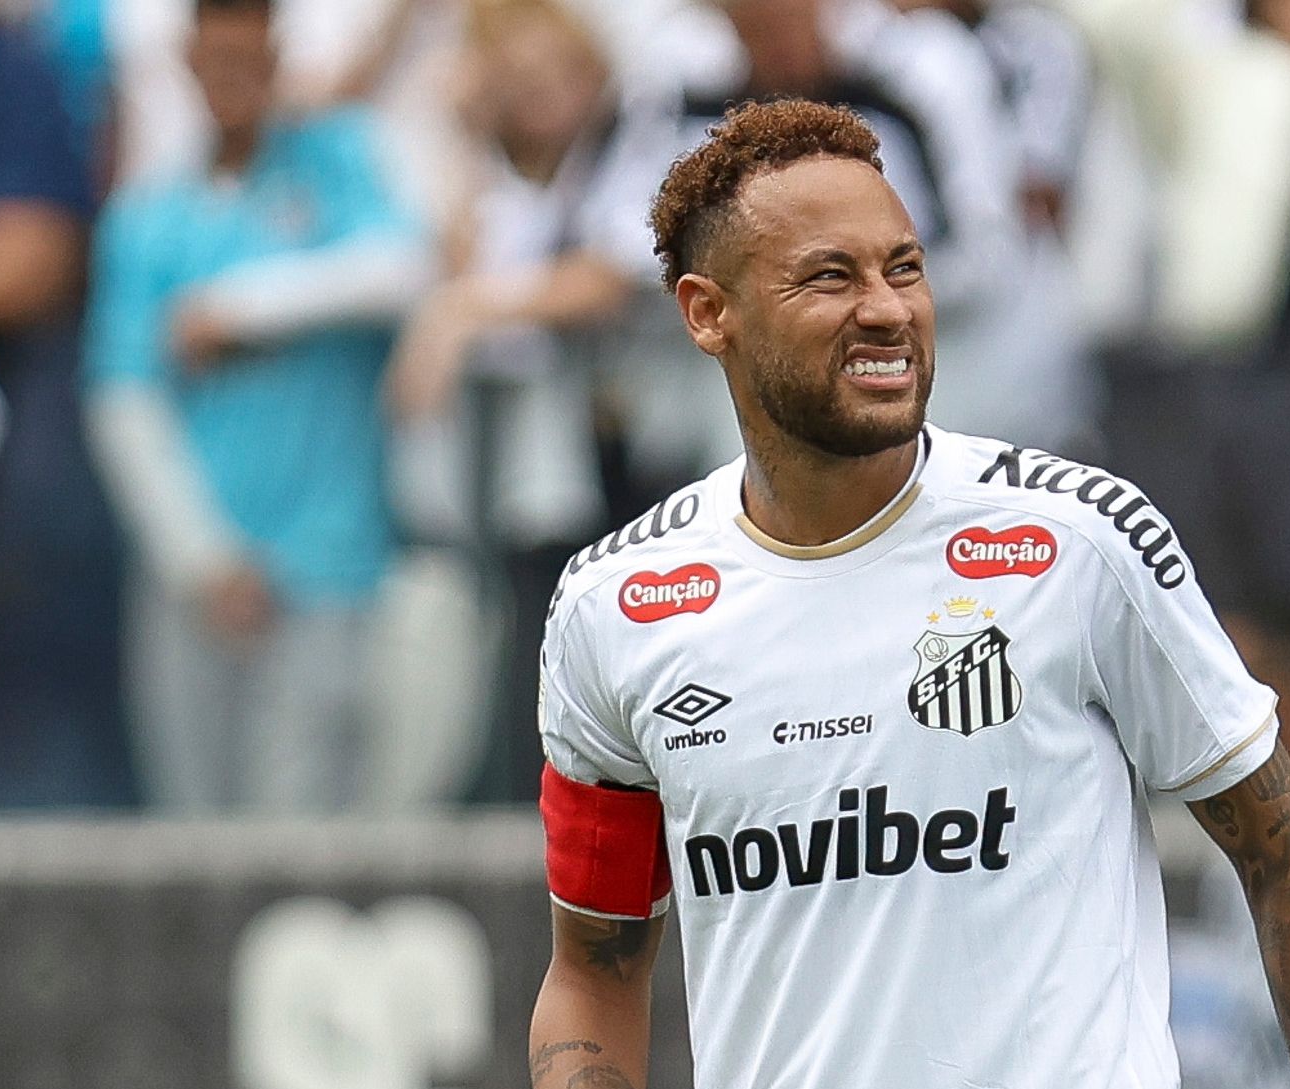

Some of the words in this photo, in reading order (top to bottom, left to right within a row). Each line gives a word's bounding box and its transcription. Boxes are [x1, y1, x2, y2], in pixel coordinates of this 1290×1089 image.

[952, 537, 1052, 567] Canção
[623, 576, 716, 608] Canção
[664, 728, 727, 751] umbro
[685, 785, 1016, 897] novibet
